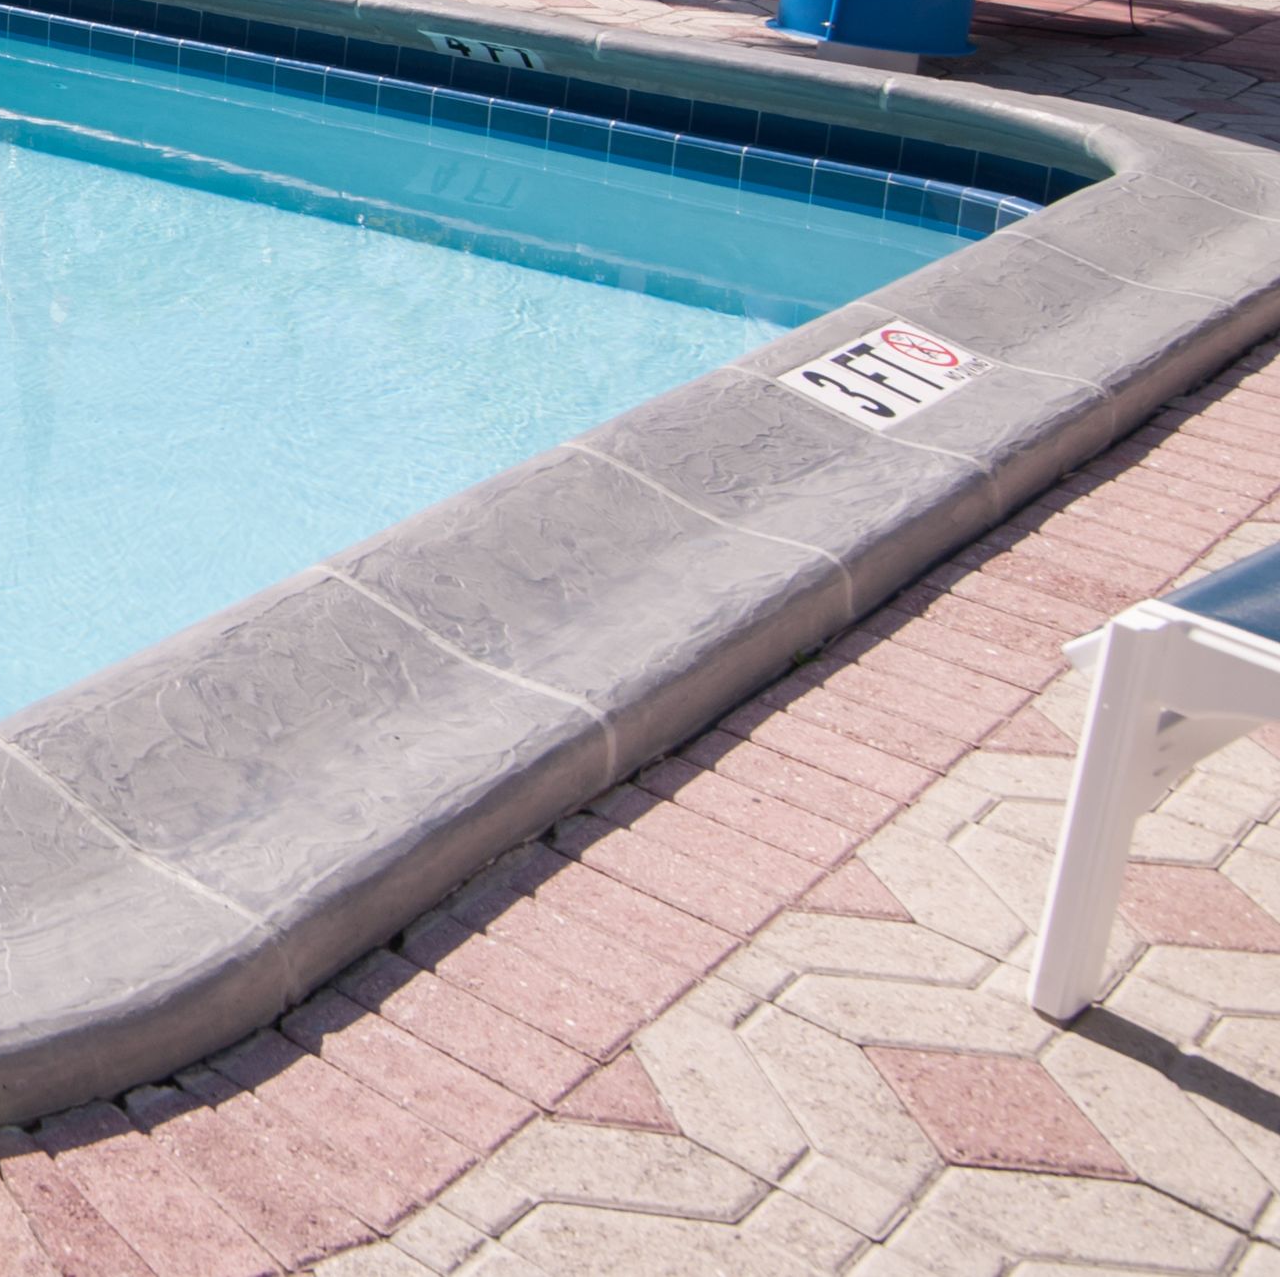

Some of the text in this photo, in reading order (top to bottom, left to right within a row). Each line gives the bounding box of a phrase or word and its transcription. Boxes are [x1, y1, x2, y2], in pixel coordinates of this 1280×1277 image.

[444, 36, 472, 57] 4
[802, 371, 896, 418] 3
[830, 343, 944, 403] FT
